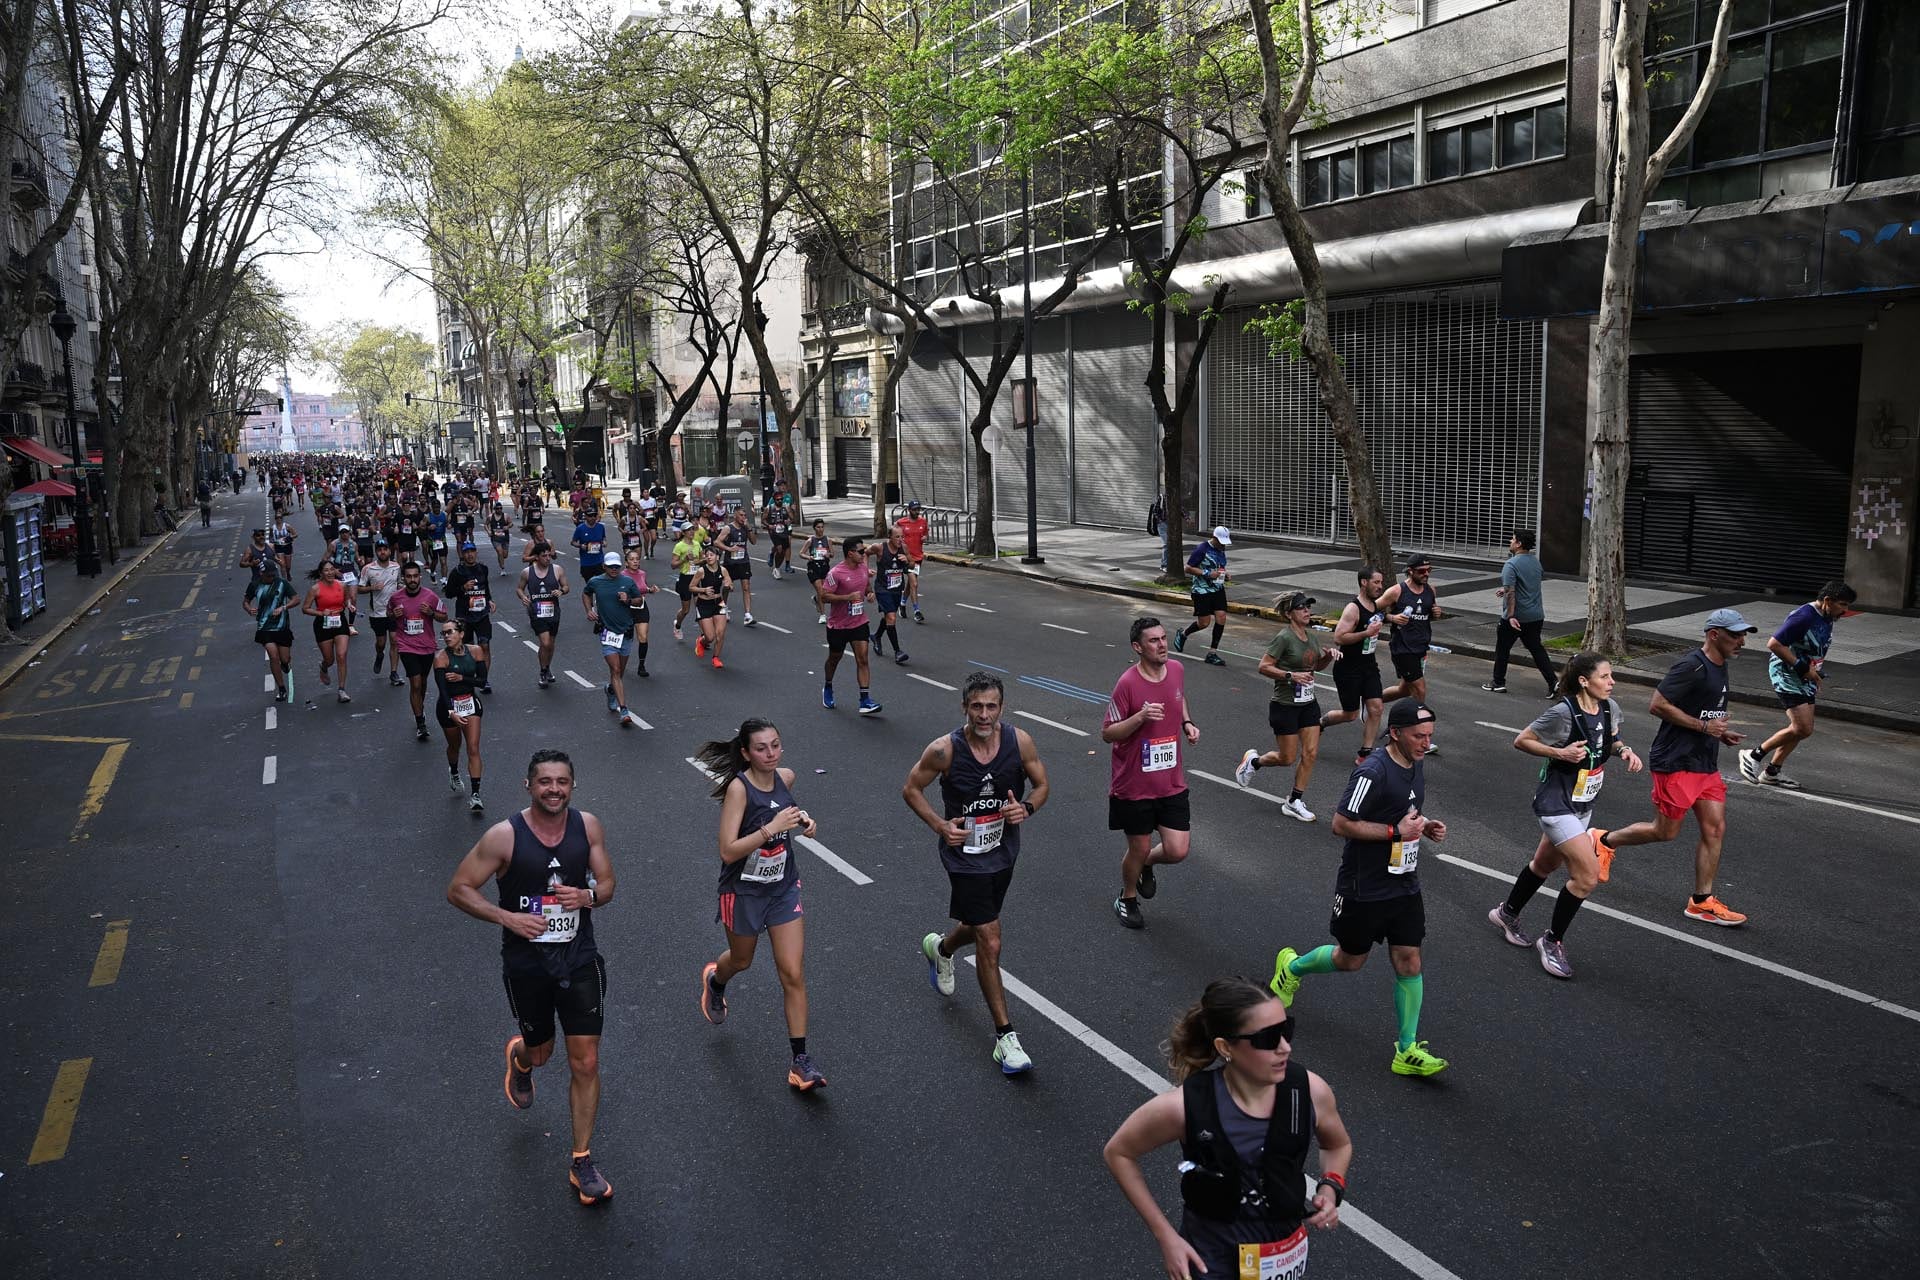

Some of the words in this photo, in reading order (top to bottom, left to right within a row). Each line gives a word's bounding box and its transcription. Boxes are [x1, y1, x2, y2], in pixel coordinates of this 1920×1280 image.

[1154, 751, 1174, 763] 9106
[759, 862, 784, 877] 15887
[532, 901, 539, 912] F
[548, 916, 576, 932] 9334
